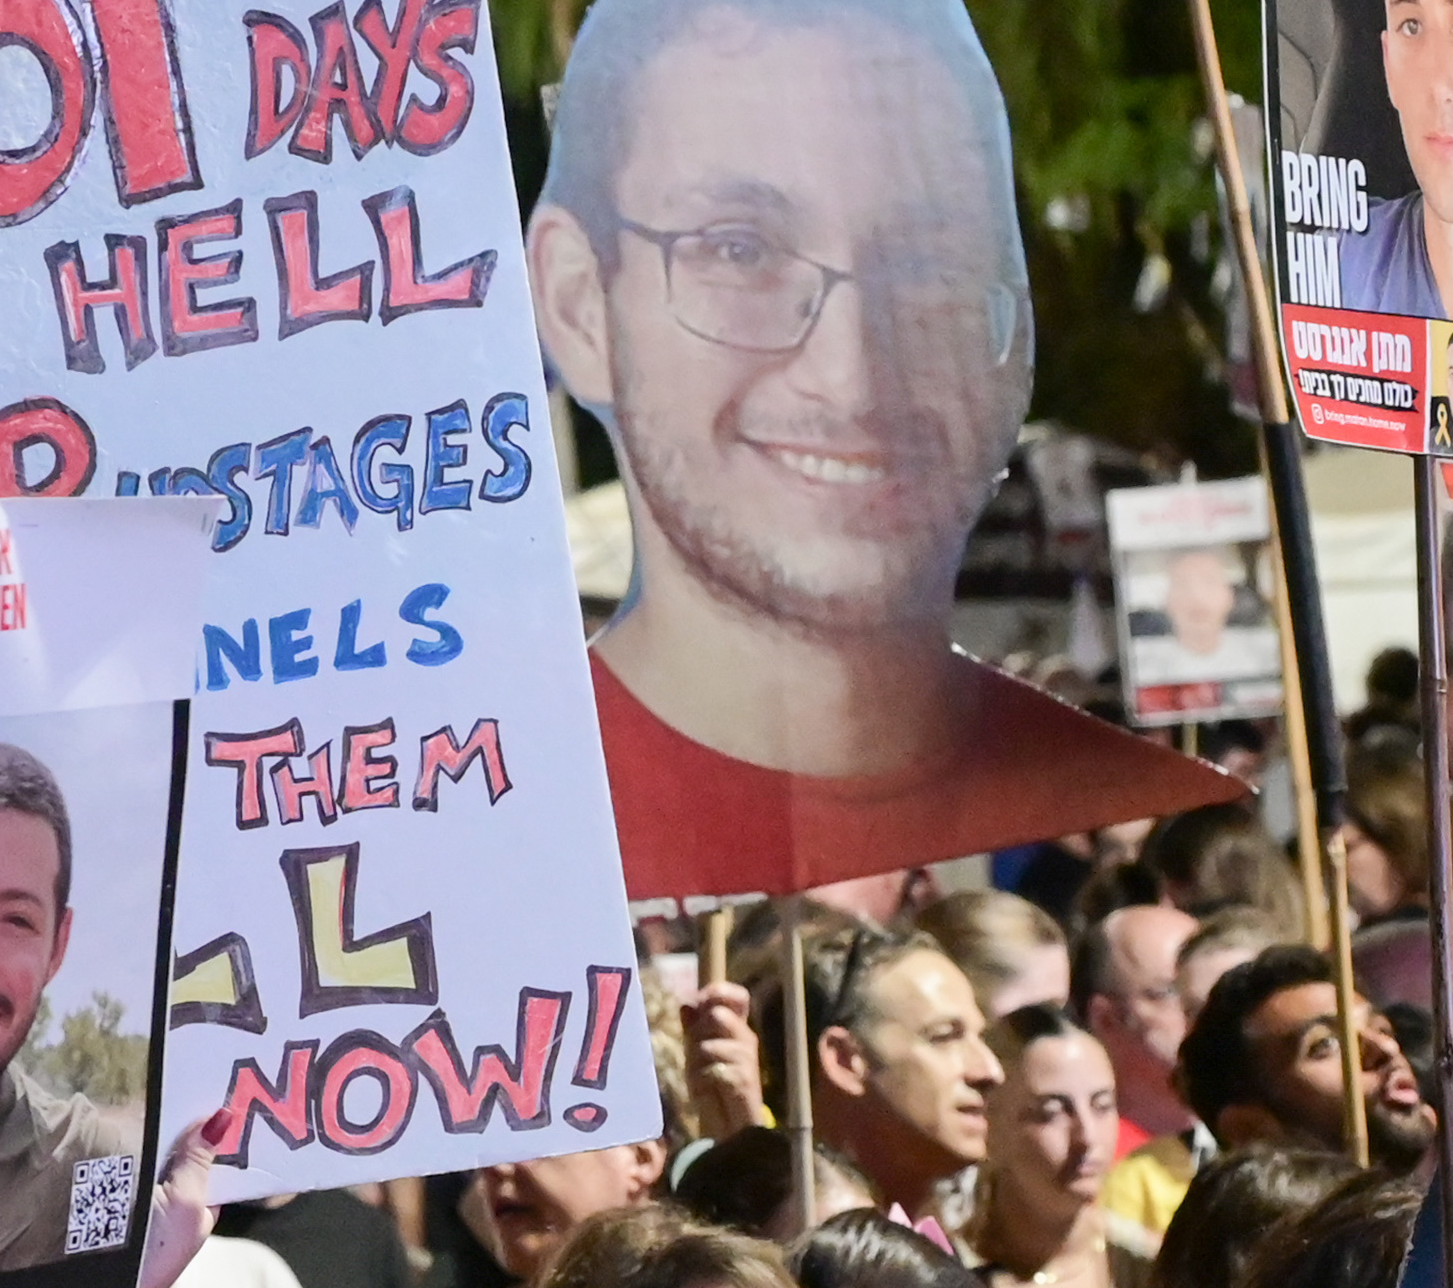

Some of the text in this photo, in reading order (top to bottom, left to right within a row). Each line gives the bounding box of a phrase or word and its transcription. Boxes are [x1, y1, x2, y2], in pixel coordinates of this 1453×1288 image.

[1282, 150, 1368, 233] BRING
[43, 187, 498, 374] HELL
[1287, 231, 1341, 309] HIM
[1292, 320, 1411, 373] מתן אנגרסט
[194, 582, 463, 694] NELS
[204, 717, 511, 830] THEM
[213, 965, 631, 1170] NOW!
